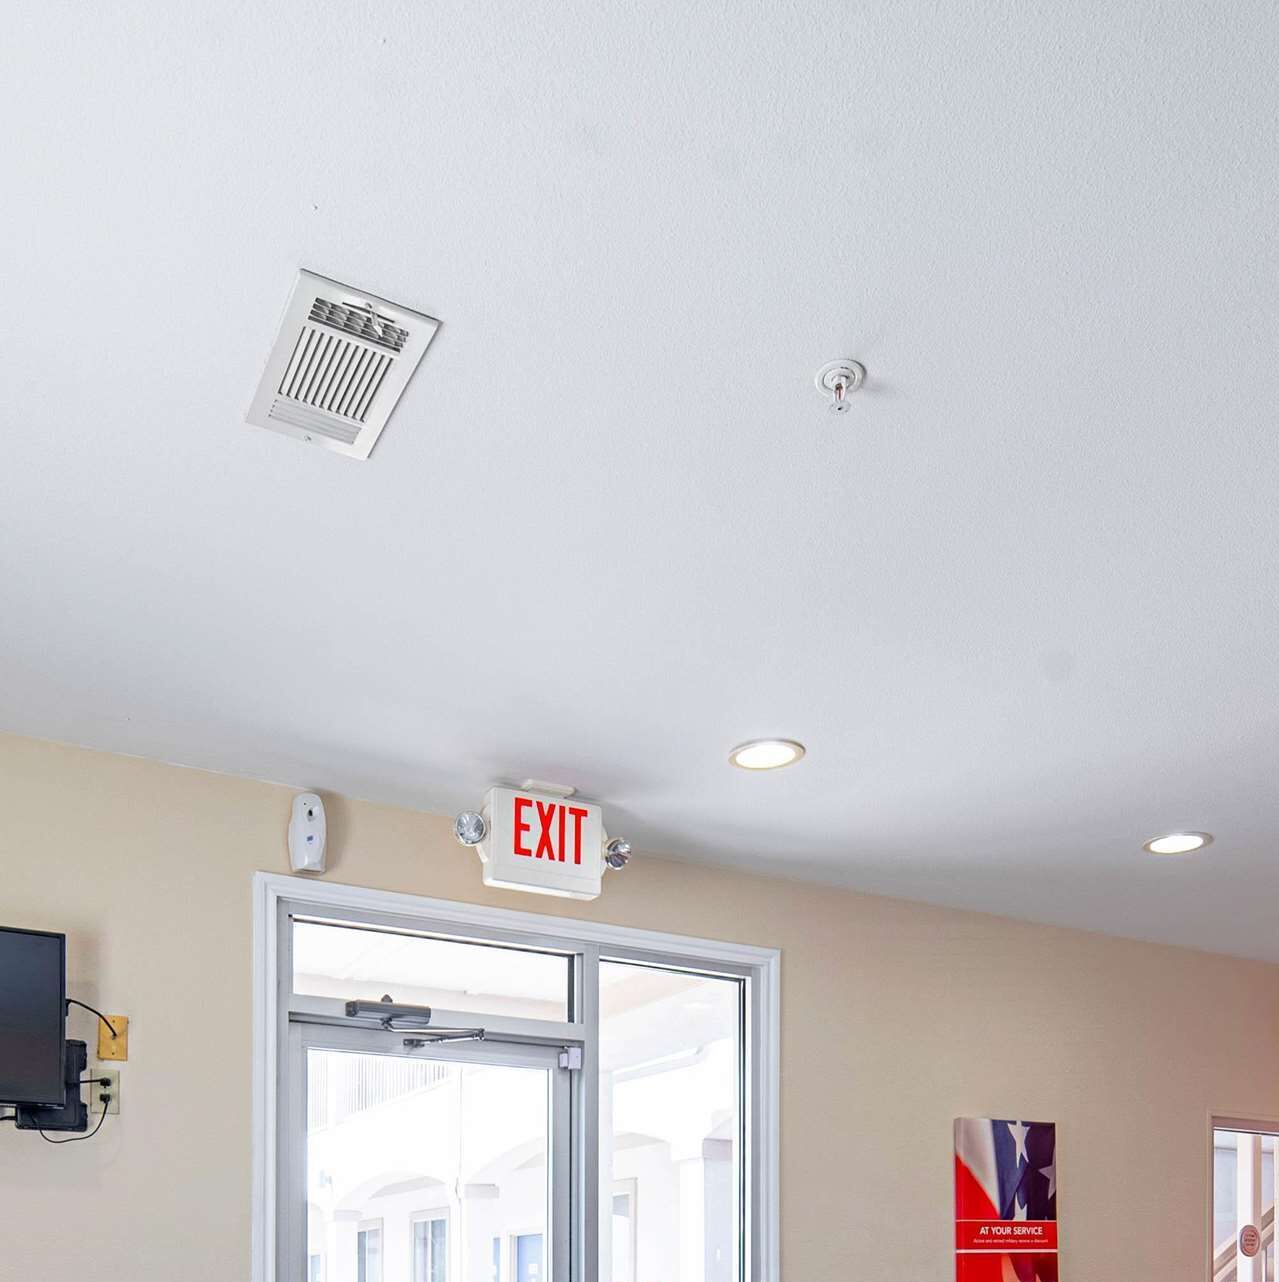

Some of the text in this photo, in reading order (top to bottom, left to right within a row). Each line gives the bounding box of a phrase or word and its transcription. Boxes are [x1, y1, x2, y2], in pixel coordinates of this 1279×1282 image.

[513, 796, 588, 865] EXIT
[980, 1226, 1043, 1235] AT YOUR SERVICE
